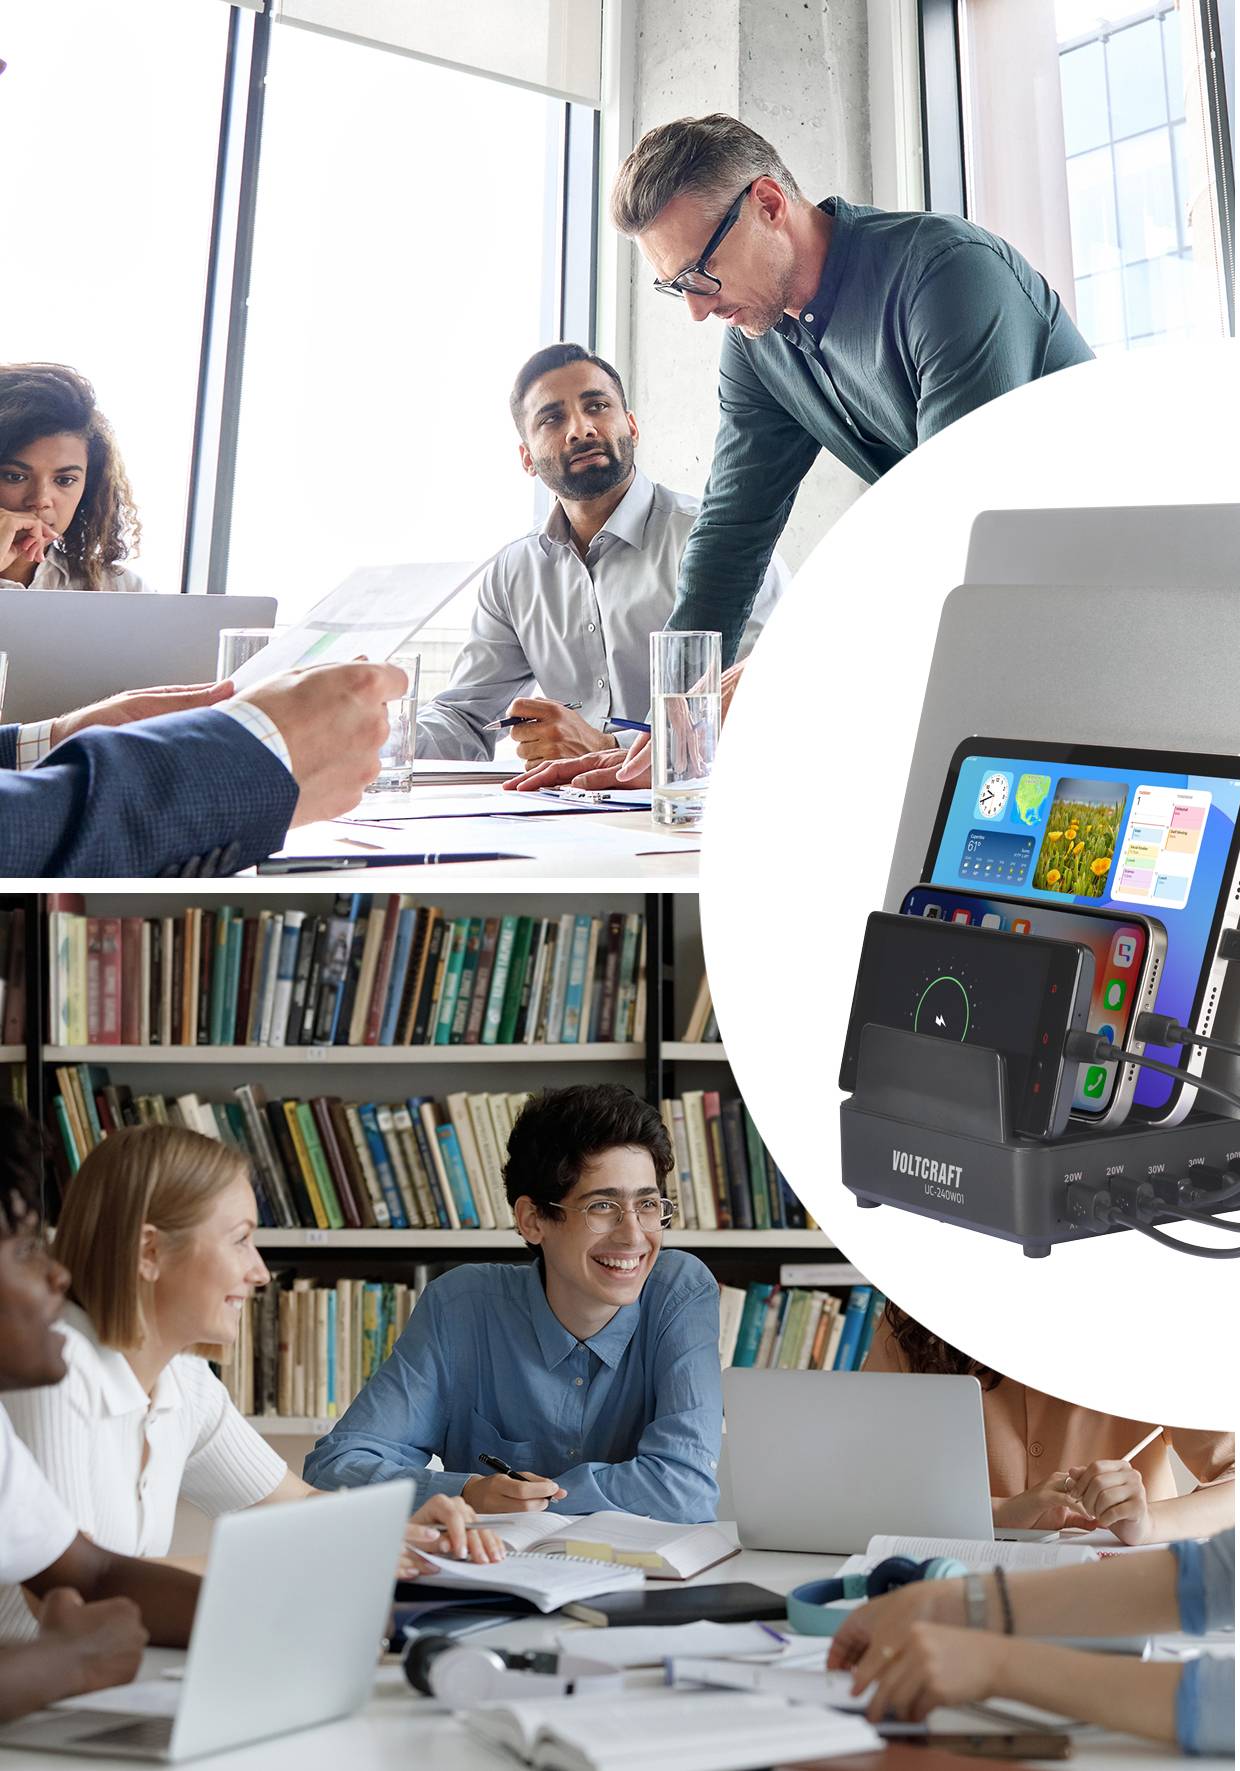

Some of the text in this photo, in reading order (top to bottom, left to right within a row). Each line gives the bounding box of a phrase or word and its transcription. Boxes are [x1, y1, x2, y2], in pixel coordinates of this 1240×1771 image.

[892, 1149, 963, 1188] VOLTCRAFT
[1105, 1164, 1125, 1176] 20W
[1147, 1163, 1166, 1175] 30W
[1063, 1171, 1084, 1183] 20W
[924, 1184, 965, 1205] UC-240W01
